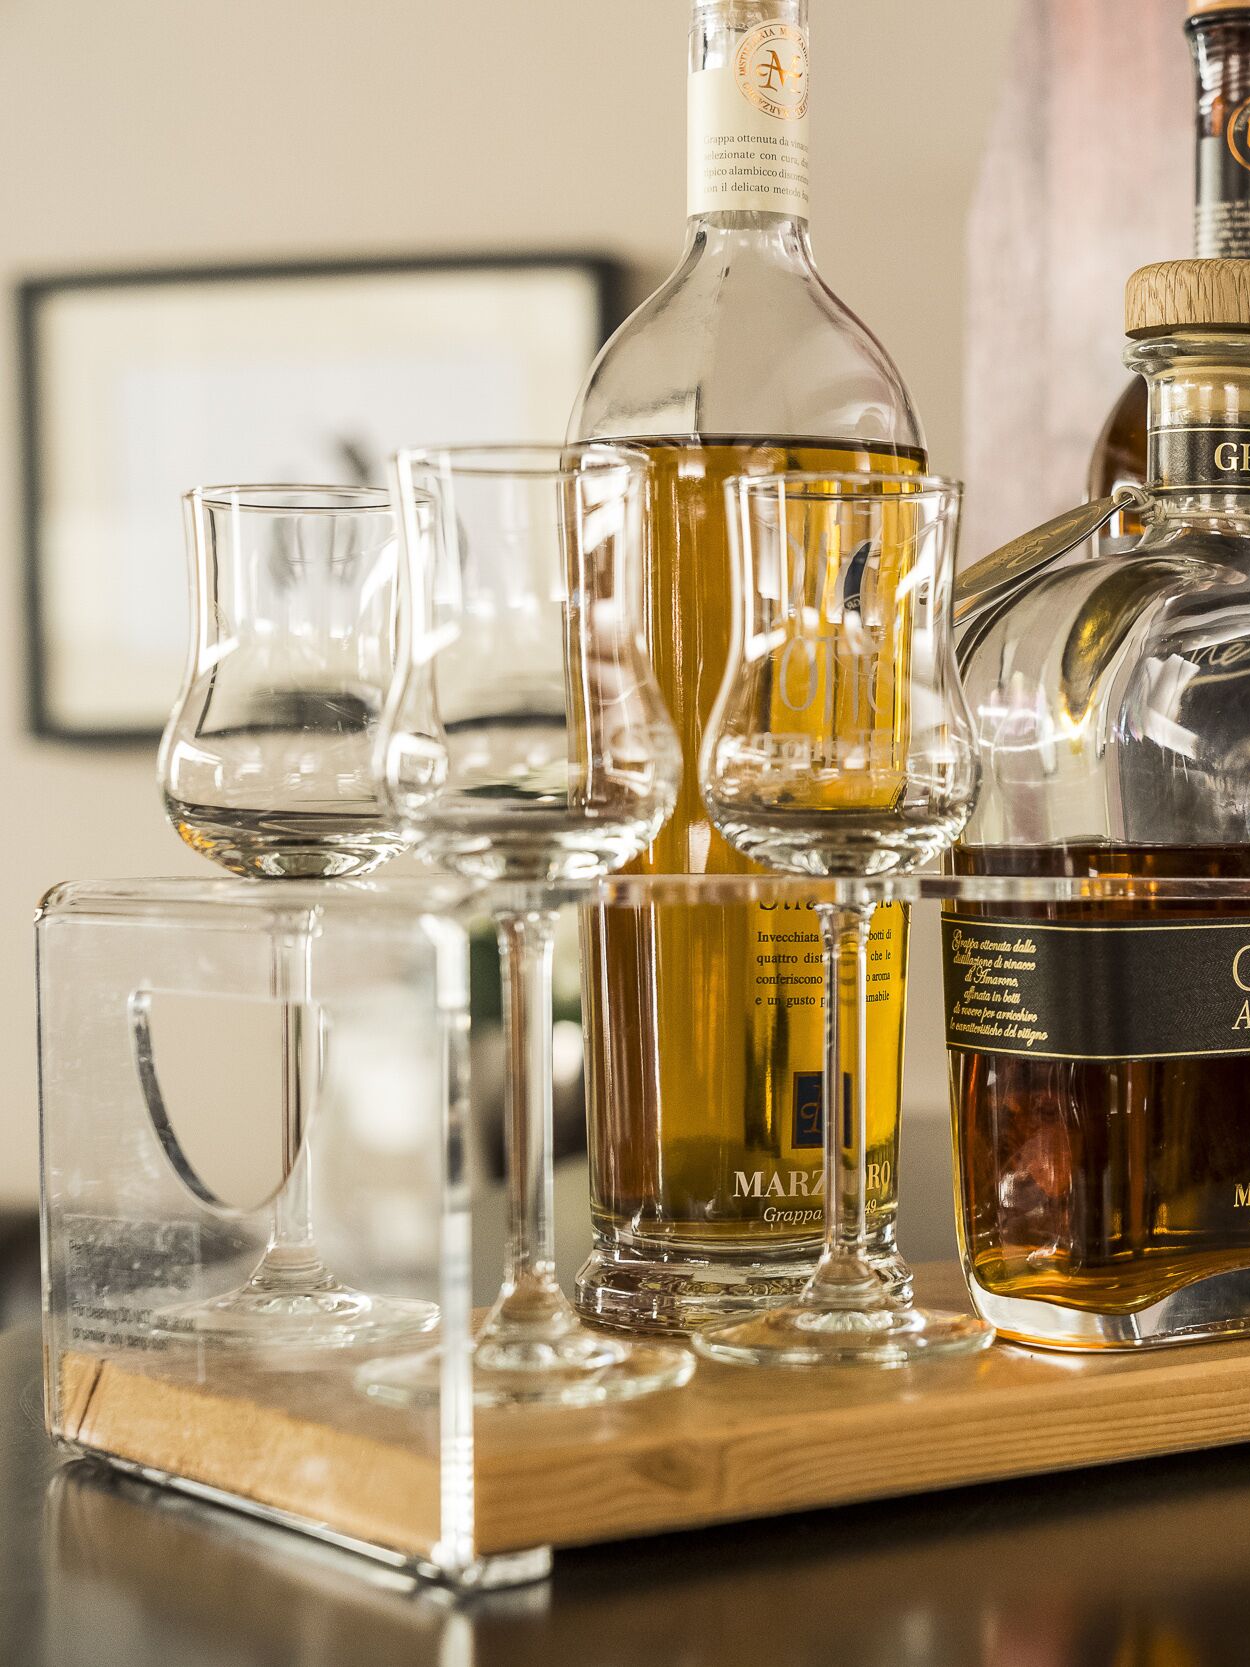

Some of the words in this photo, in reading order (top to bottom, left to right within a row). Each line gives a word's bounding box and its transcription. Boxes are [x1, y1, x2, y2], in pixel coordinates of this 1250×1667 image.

[703, 135, 735, 146] Grappa
[737, 134, 777, 144] ottenuta
[779, 136, 789, 146] da
[760, 153, 777, 161] con
[728, 166, 777, 177] alambicco
[721, 182, 727, 192] il
[731, 182, 770, 193] delicato
[757, 931, 819, 943] Invecchiata
[869, 930, 885, 941] botti
[886, 929, 892, 940] di
[952, 929, 979, 953] Grappa
[1012, 939, 1037, 953] dalla
[756, 953, 798, 966] quattro
[803, 953, 824, 964] dist
[870, 952, 883, 961] che
[885, 950, 891, 960] le
[993, 955, 1003, 969] di
[756, 973, 823, 985] conferiscono
[871, 972, 890, 982] aroma
[965, 970, 972, 983] di
[755, 997, 762, 1005] e
[767, 997, 783, 1005] un
[786, 994, 816, 1008] gusto
[991, 990, 1002, 1002] in
[953, 1001, 961, 1014] di
[981, 1007, 996, 1024] per
[1004, 1024, 1017, 1038] del
[763, 1207, 823, 1225] Grappa
